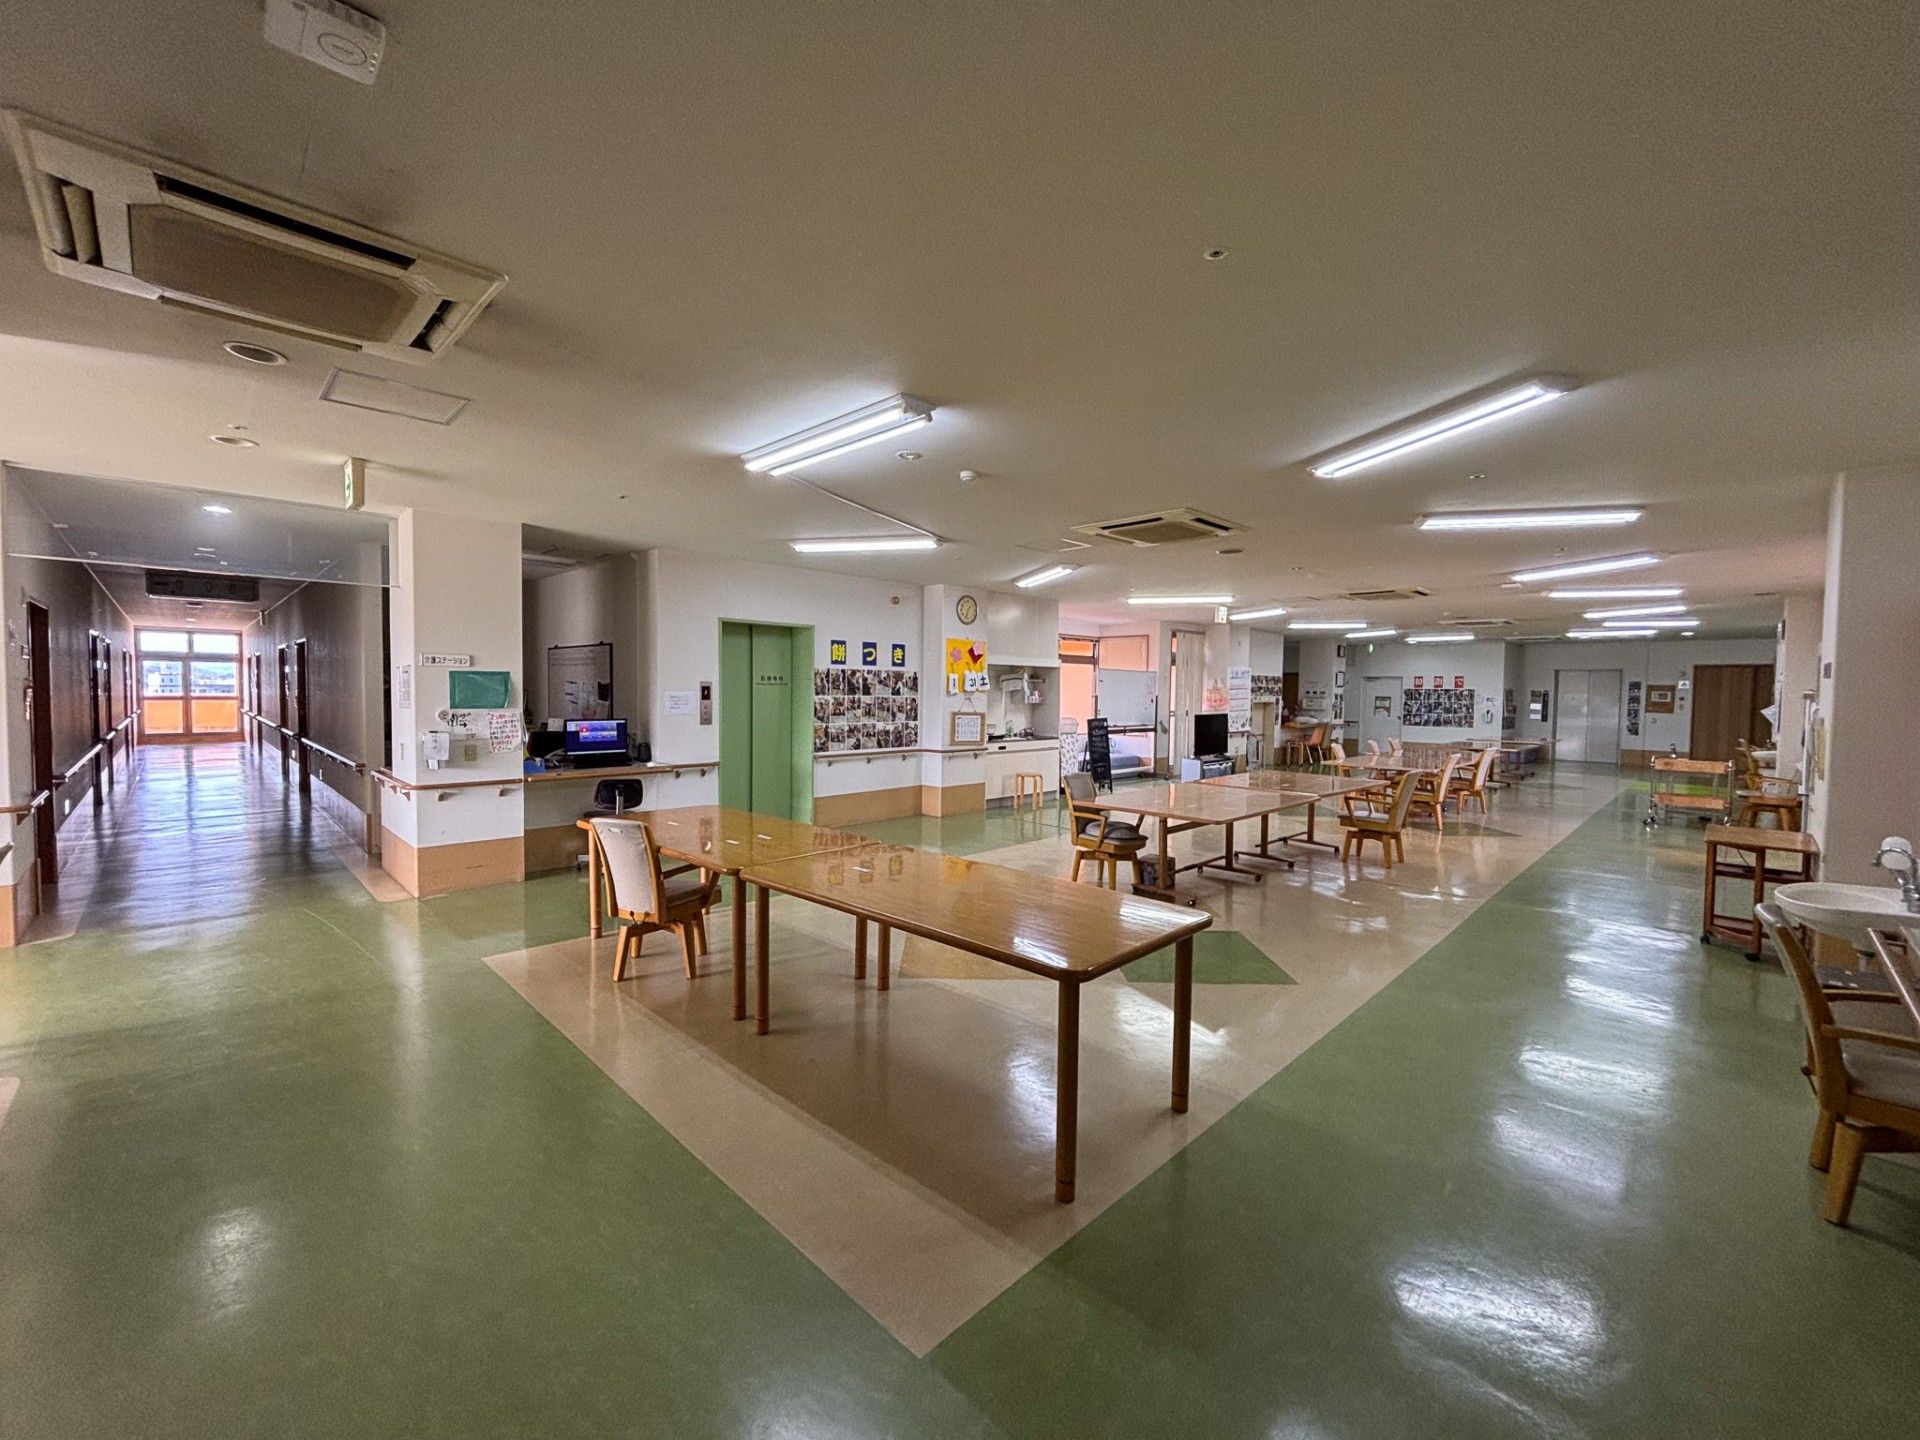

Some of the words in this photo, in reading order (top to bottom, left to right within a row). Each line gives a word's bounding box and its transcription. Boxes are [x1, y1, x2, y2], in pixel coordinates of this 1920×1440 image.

[832, 643, 904, 664] 餅つき
[424, 656, 469, 665] 介護ステーション
[969, 677, 977, 688] 31
[980, 675, 989, 687] 土
